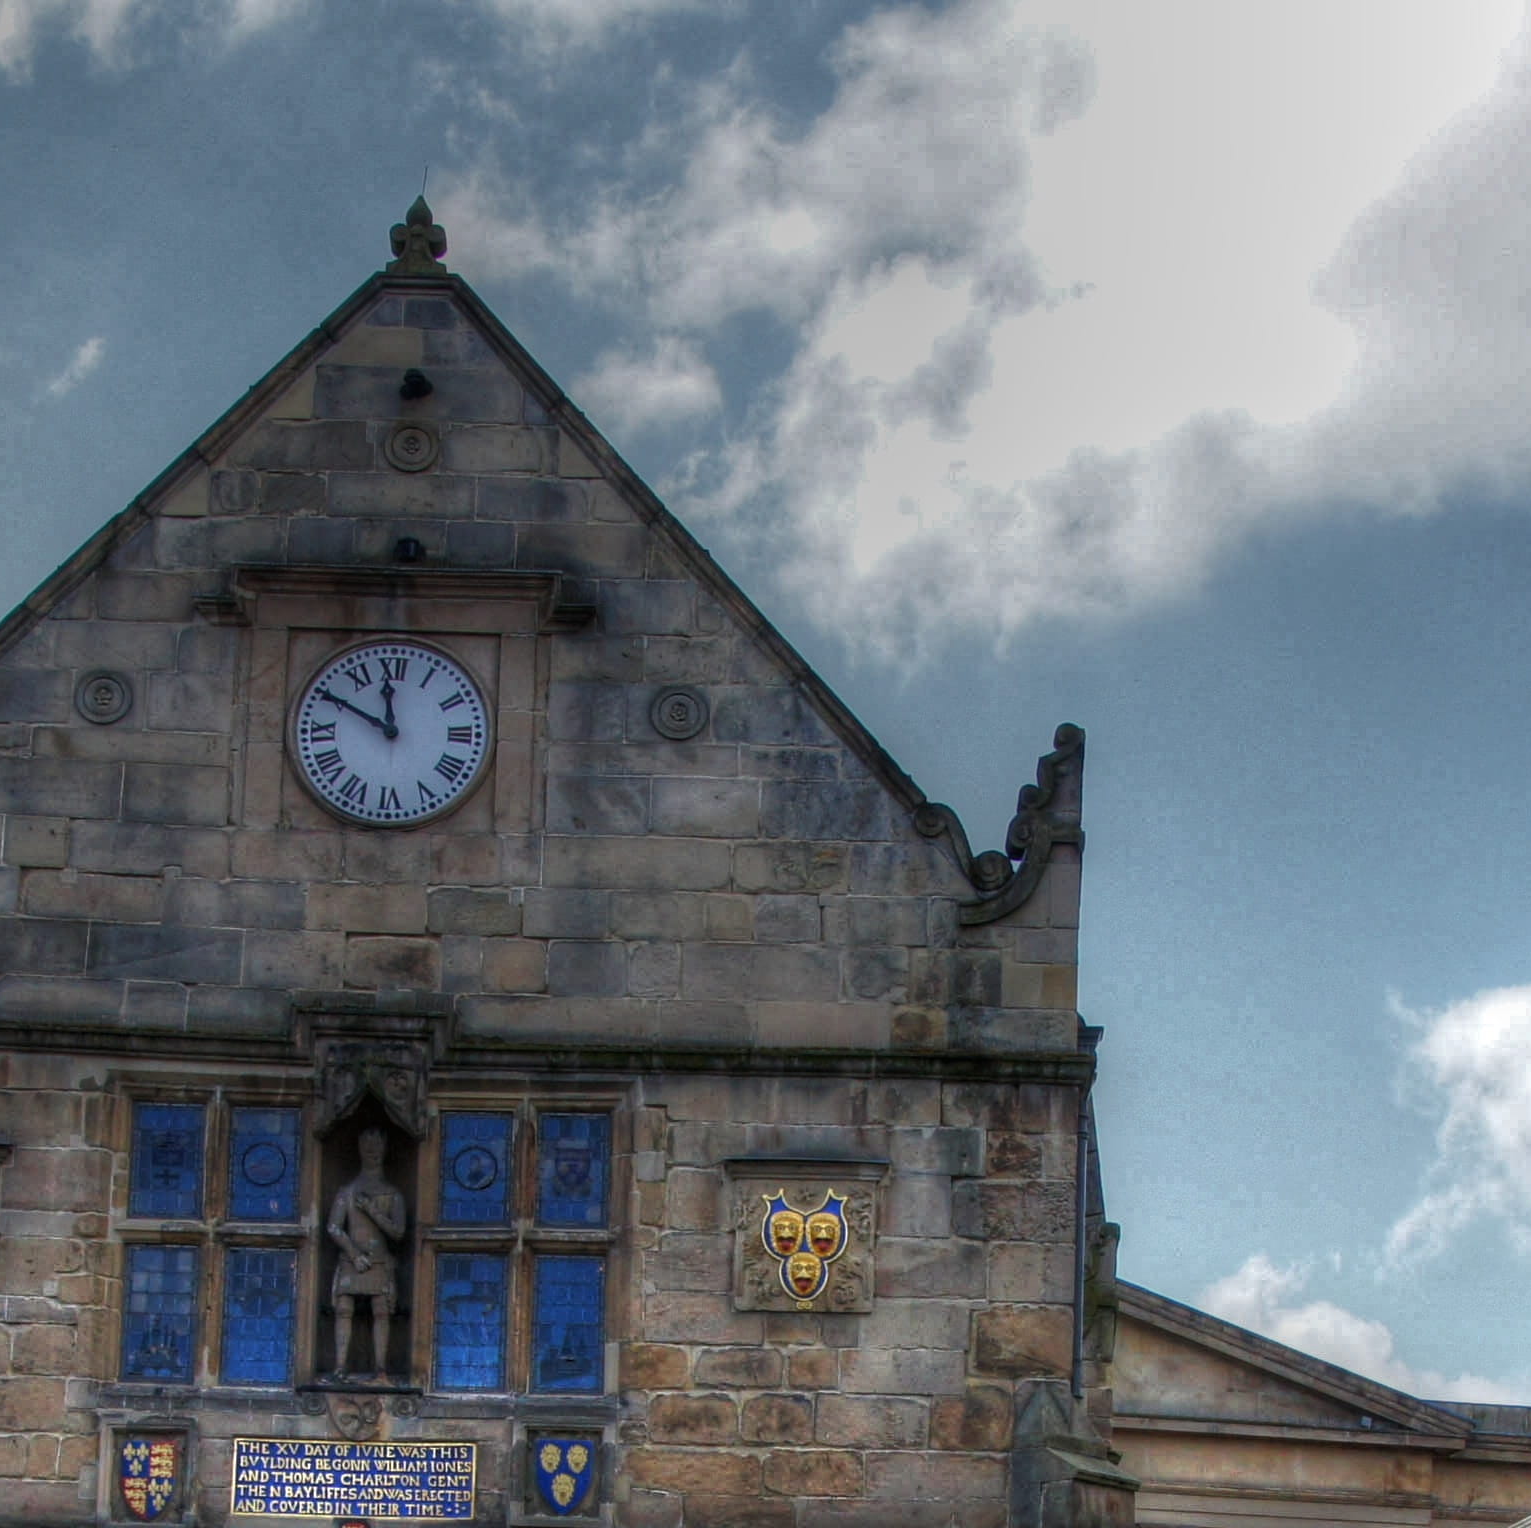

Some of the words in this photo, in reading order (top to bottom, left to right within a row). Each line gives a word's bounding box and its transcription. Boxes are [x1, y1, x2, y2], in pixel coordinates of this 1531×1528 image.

[343, 662, 372, 692] XI
[378, 657, 410, 681] XII
[311, 720, 337, 744] IX
[447, 725, 472, 745] III
[314, 748, 346, 786] VIII
[338, 774, 368, 805] VII
[377, 786, 403, 810] VI
[239, 1441, 270, 1454] THE
[276, 1443, 299, 1455] XV
[305, 1444, 330, 1456] DAY
[335, 1445, 351, 1456] OF
[397, 1446, 426, 1458] WAS
[430, 1447, 468, 1459] THIS
[240, 1455, 311, 1470] BVYLDING
[374, 1460, 427, 1472] WILLIAM
[238, 1470, 269, 1482] AND
[271, 1471, 334, 1484] THOMAS
[341, 1473, 420, 1487] CHARLTON
[428, 1475, 469, 1487] GENT
[285, 1486, 357, 1500] BAYLIFFES
[358, 1488, 384, 1500] AND
[383, 1489, 412, 1500] WAS
[414, 1490, 471, 1502] ERECTED
[236, 1499, 266, 1512] AND
[270, 1500, 333, 1514] COVERED
[335, 1502, 352, 1515] IN
[357, 1503, 400, 1515] THEIR
